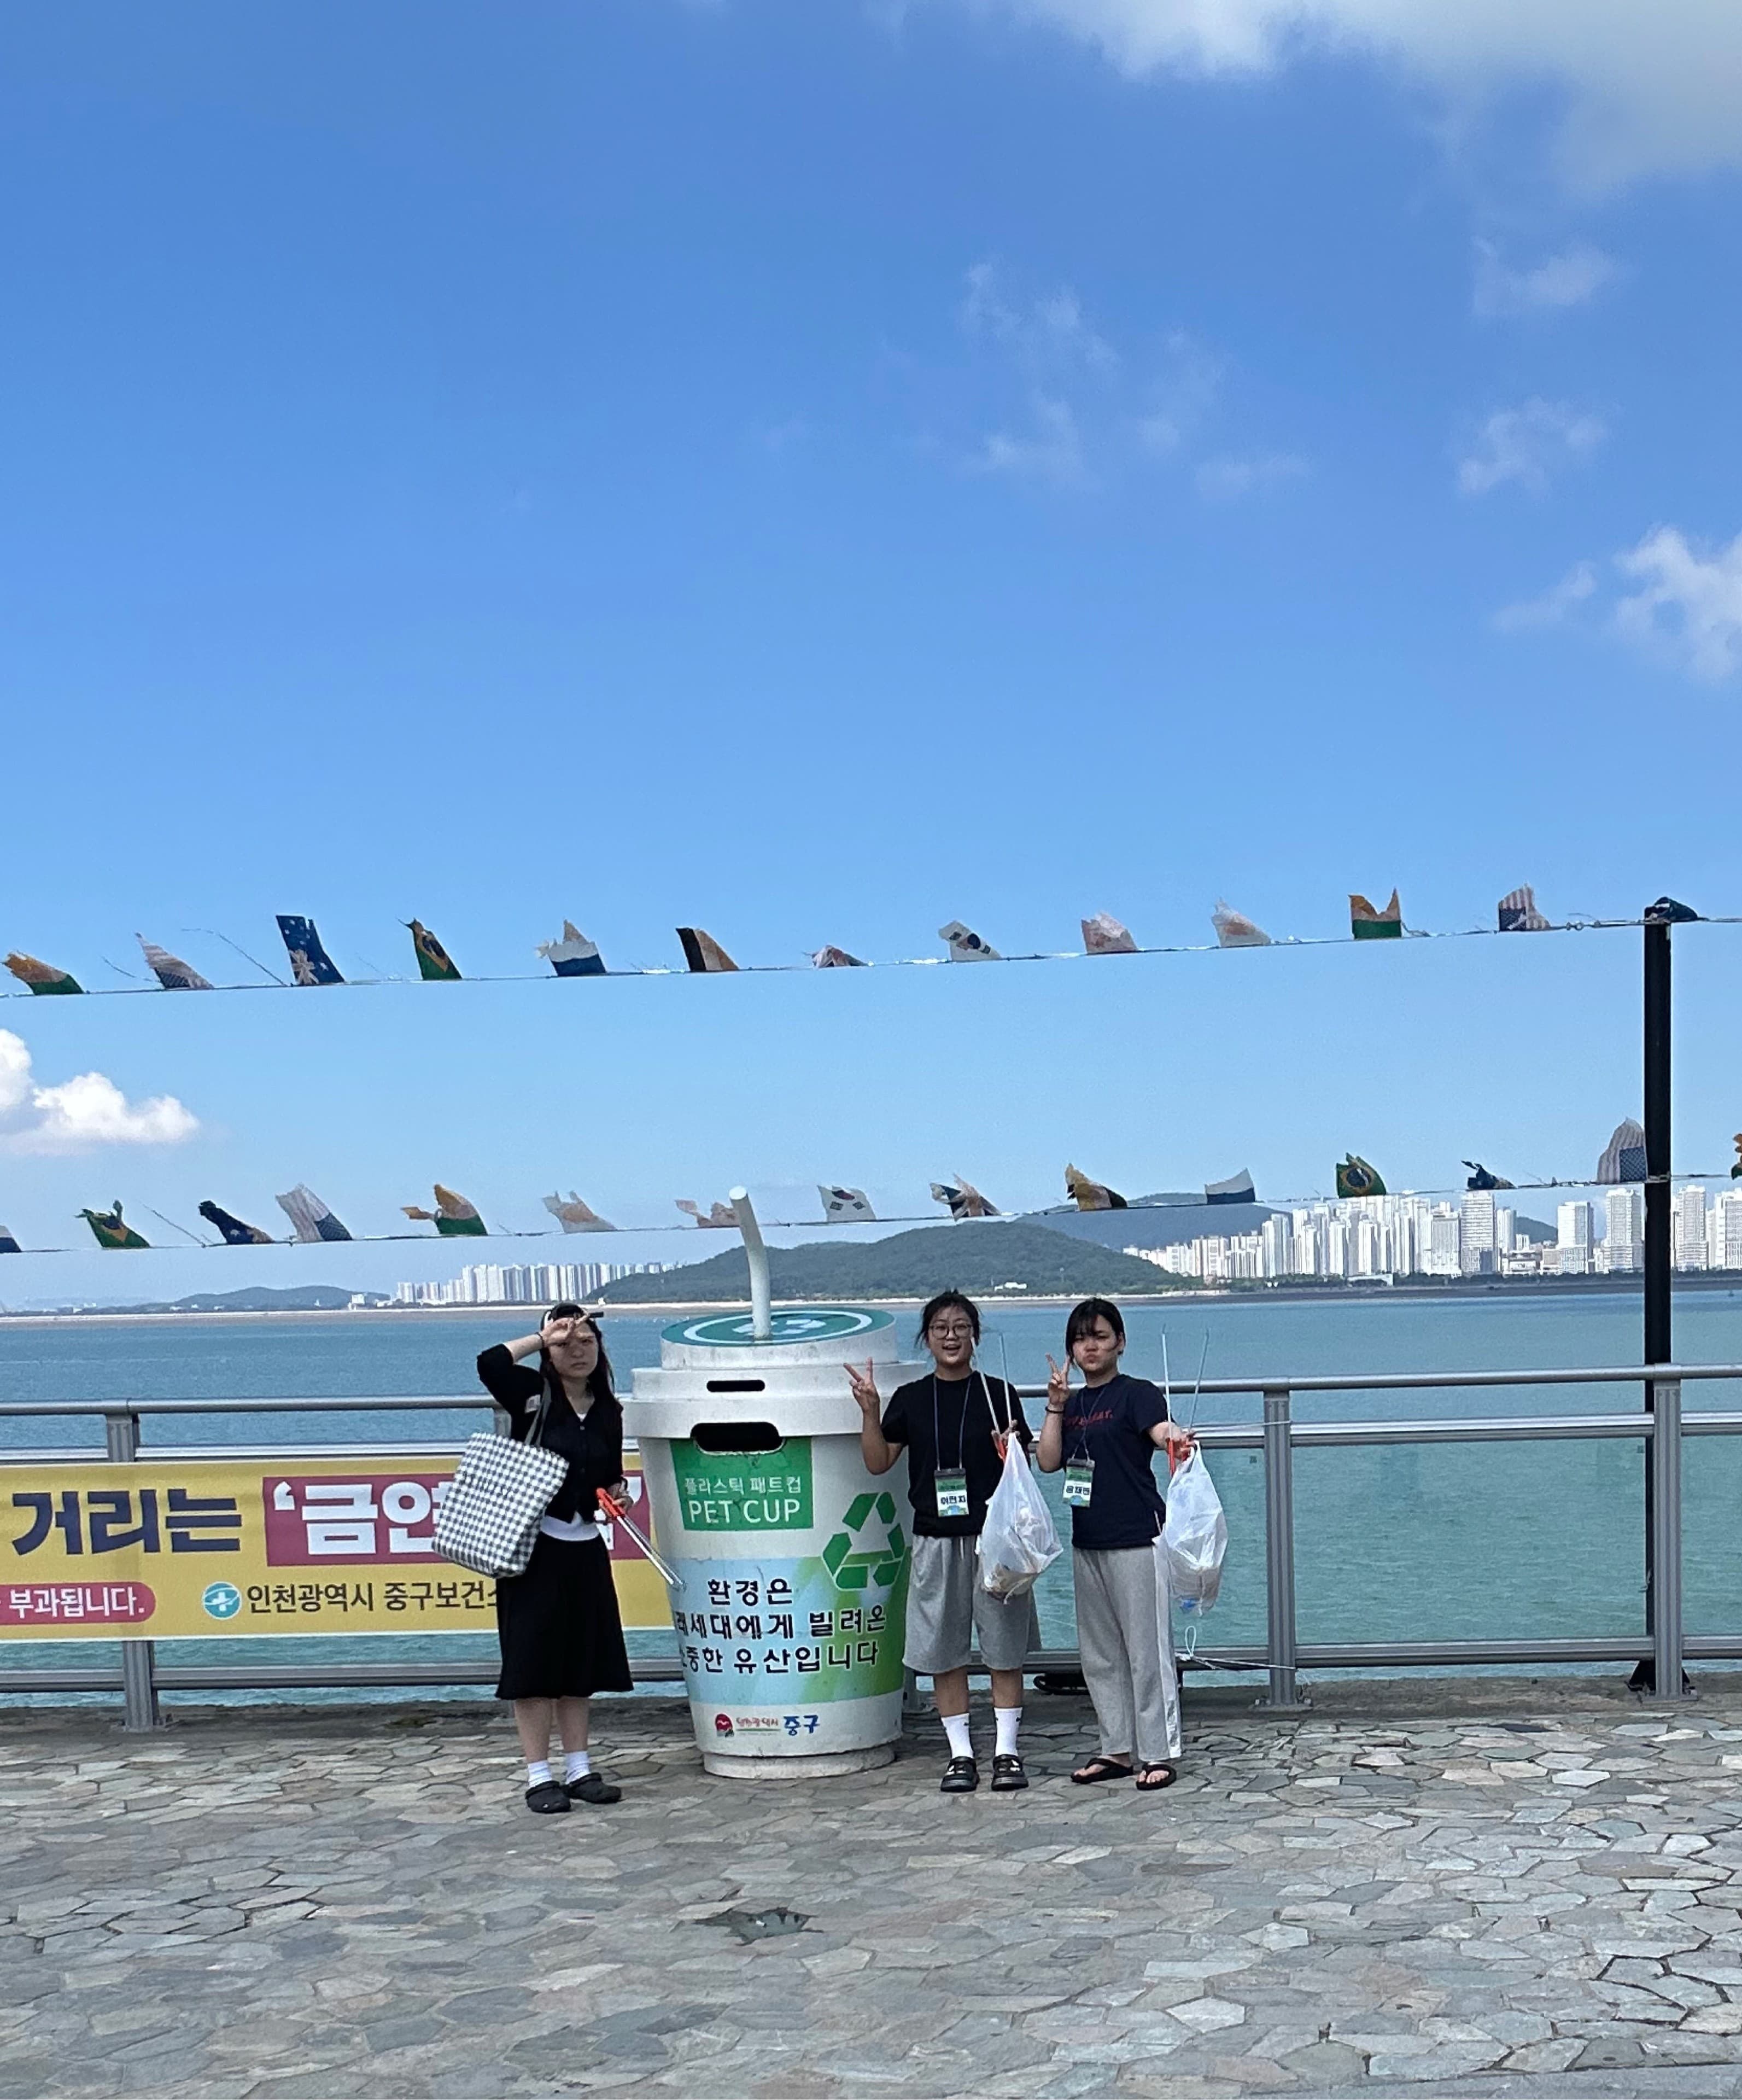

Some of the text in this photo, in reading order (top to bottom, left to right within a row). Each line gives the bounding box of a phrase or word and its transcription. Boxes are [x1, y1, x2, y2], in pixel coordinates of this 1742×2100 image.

[685, 1477, 744, 1496] 플라스틱
[11, 1488, 242, 1556] 거리는
[688, 1498, 800, 1523] PET CUP
[9, 1586, 145, 1619] 부과됩니다.
[247, 1583, 374, 1613] 인천광역시
[708, 1578, 792, 1607] 환경은
[809, 1605, 886, 1637] 빌려온
[682, 1641, 879, 1674] 중한 유산입니다
[783, 1714, 820, 1736] 중구
